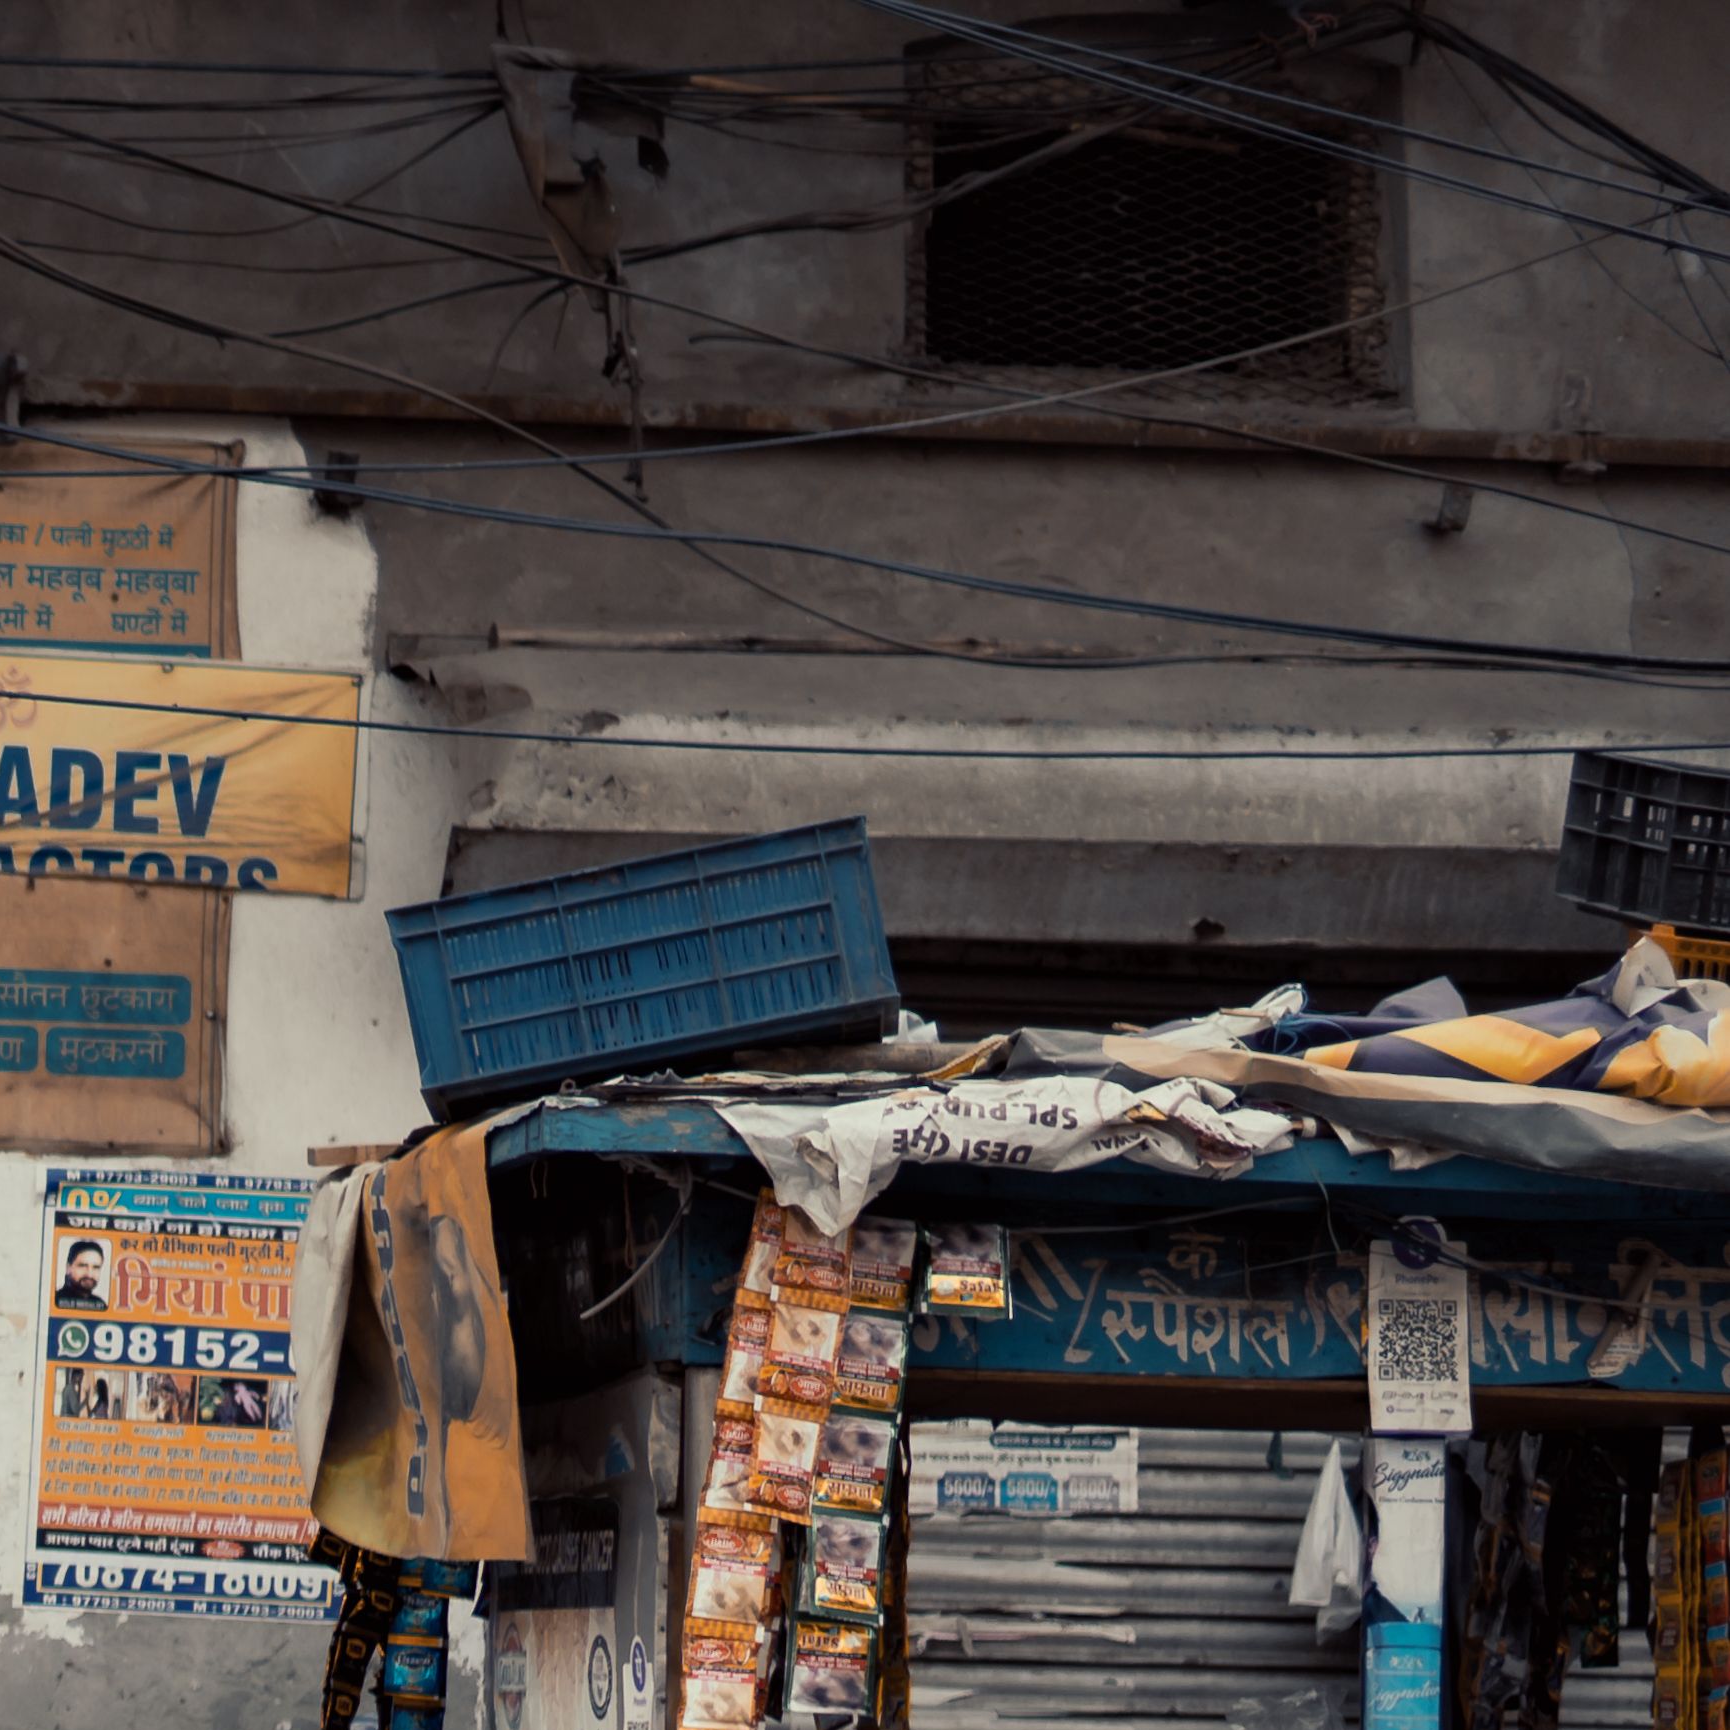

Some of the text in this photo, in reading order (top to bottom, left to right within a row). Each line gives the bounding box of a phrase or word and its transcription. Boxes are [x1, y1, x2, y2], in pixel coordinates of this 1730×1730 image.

[51, 521, 94, 547] पत्नी
[159, 524, 174, 549] में
[25, 565, 105, 602] महबूब
[114, 567, 200, 605] महबूबा
[35, 603, 55, 631] में
[170, 611, 189, 635] में
[960, 1139, 1033, 1164] DESI
[96, 1172, 198, 1187] 97793-29003
[120, 1238, 138, 1251] कर
[115, 1250, 232, 1318] मियां
[959, 1279, 1000, 1293] Safal
[1394, 1273, 1440, 1285] PhonePe
[93, 1322, 295, 1371] 98152-
[196, 1516, 212, 1532] का
[72, 1596, 176, 1611] 97793-29003
[222, 1603, 325, 1619] 97793-29003
